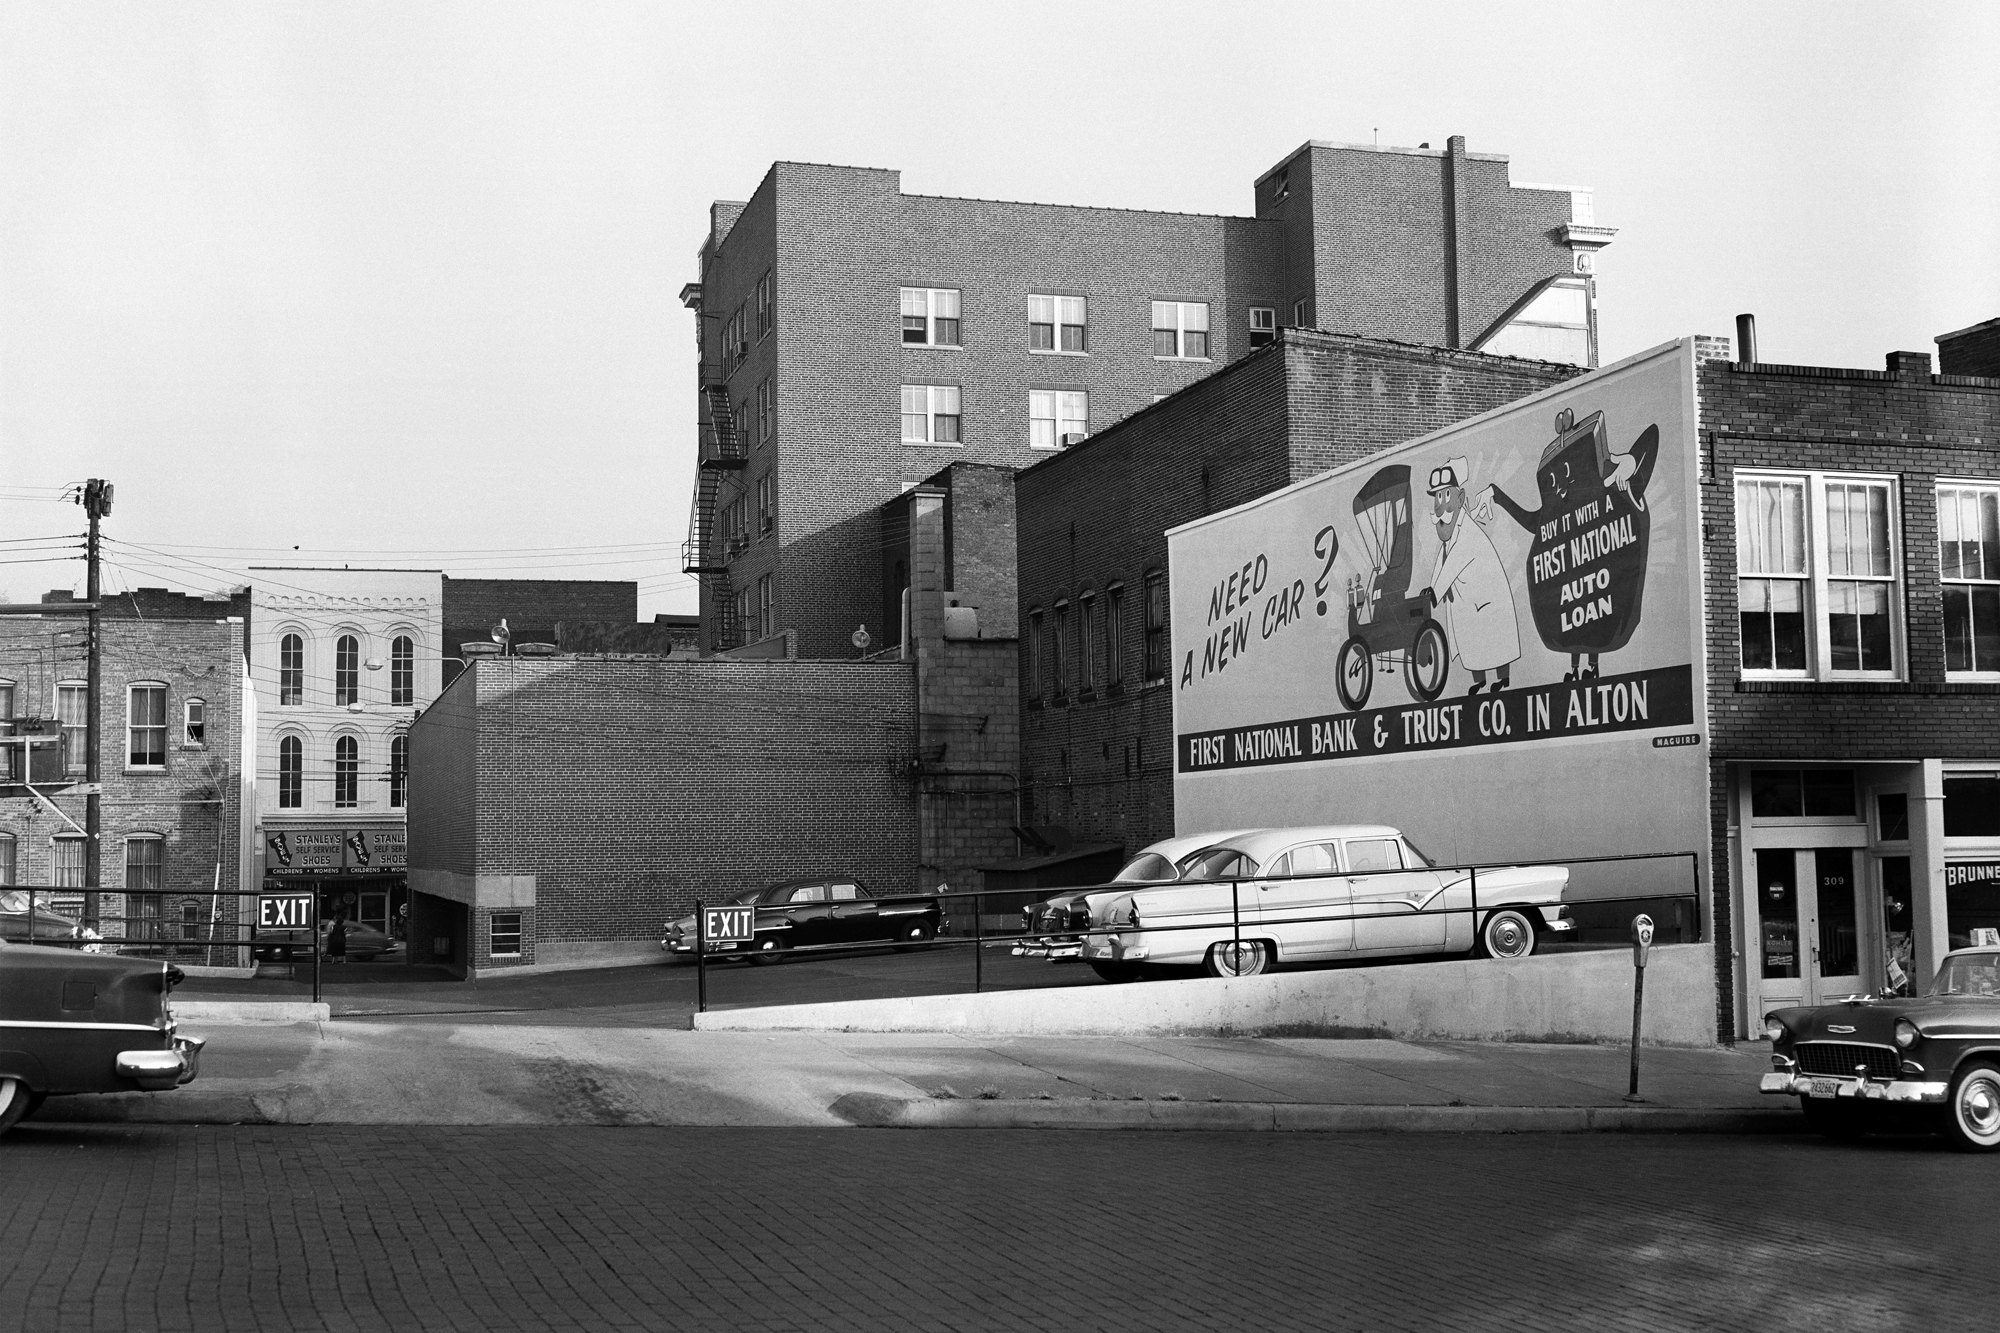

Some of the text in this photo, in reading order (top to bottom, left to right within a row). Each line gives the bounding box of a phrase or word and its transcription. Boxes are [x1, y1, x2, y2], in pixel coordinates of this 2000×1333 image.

[1540, 494, 1614, 542] BUY IT WITH A
[1533, 514, 1637, 584] FIRST NATIONAL
[1207, 553, 1268, 627] NEED
[1560, 568, 1610, 606] AUTO
[1561, 594, 1613, 633] LOAN
[1180, 649, 1194, 691] A
[1201, 610, 1252, 679] NEW
[1190, 680, 1649, 767] FIRST NATIONAL BANK & TRUST CO. IN ALTON
[1656, 735, 1696, 746] MAGUIRE
[295, 834, 341, 845] STANLEY'S
[302, 856, 330, 866] SHOES
[380, 854, 407, 865] SHOES
[1824, 876, 1844, 885] 309
[261, 899, 310, 925] EXIT
[707, 911, 751, 937] EXIT
